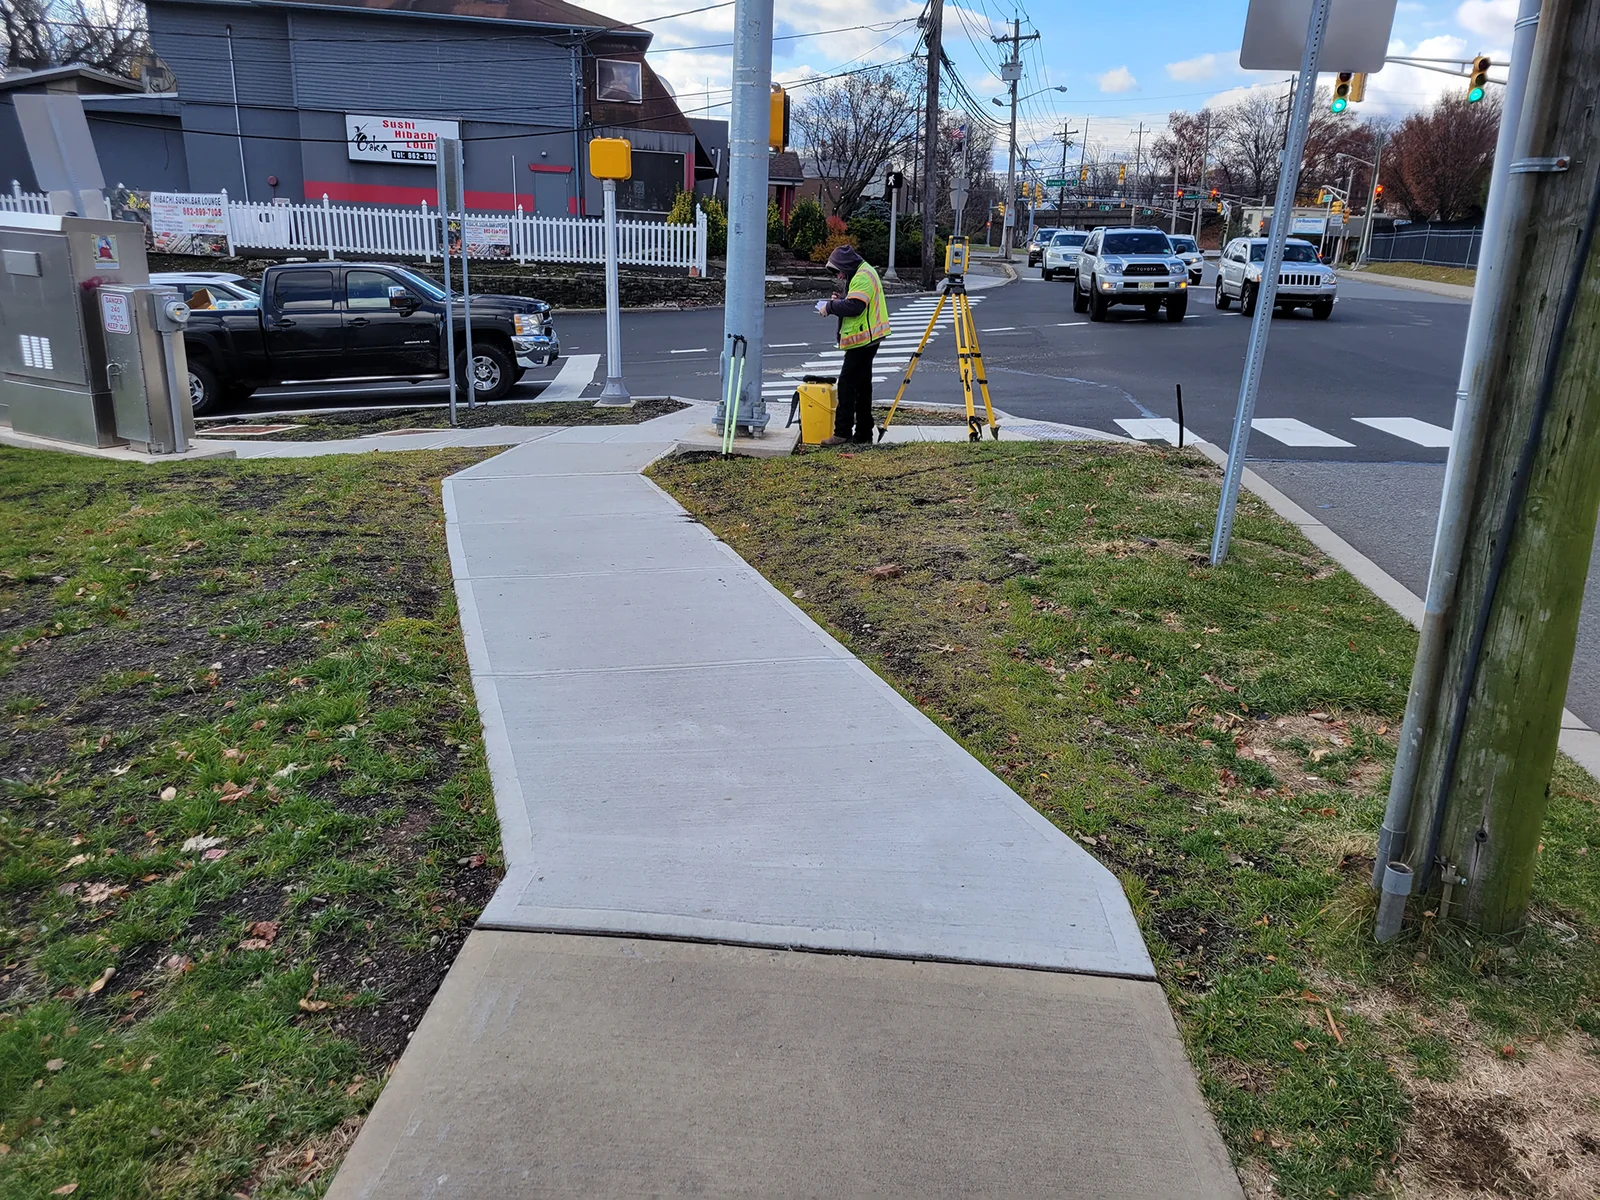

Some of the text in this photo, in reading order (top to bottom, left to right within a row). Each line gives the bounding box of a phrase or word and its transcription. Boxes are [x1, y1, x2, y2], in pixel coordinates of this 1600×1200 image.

[382, 119, 415, 130] Sushi
[406, 141, 437, 150] Loun
[110, 305, 120, 313] 240
[110, 314, 123, 322] VOLTS
